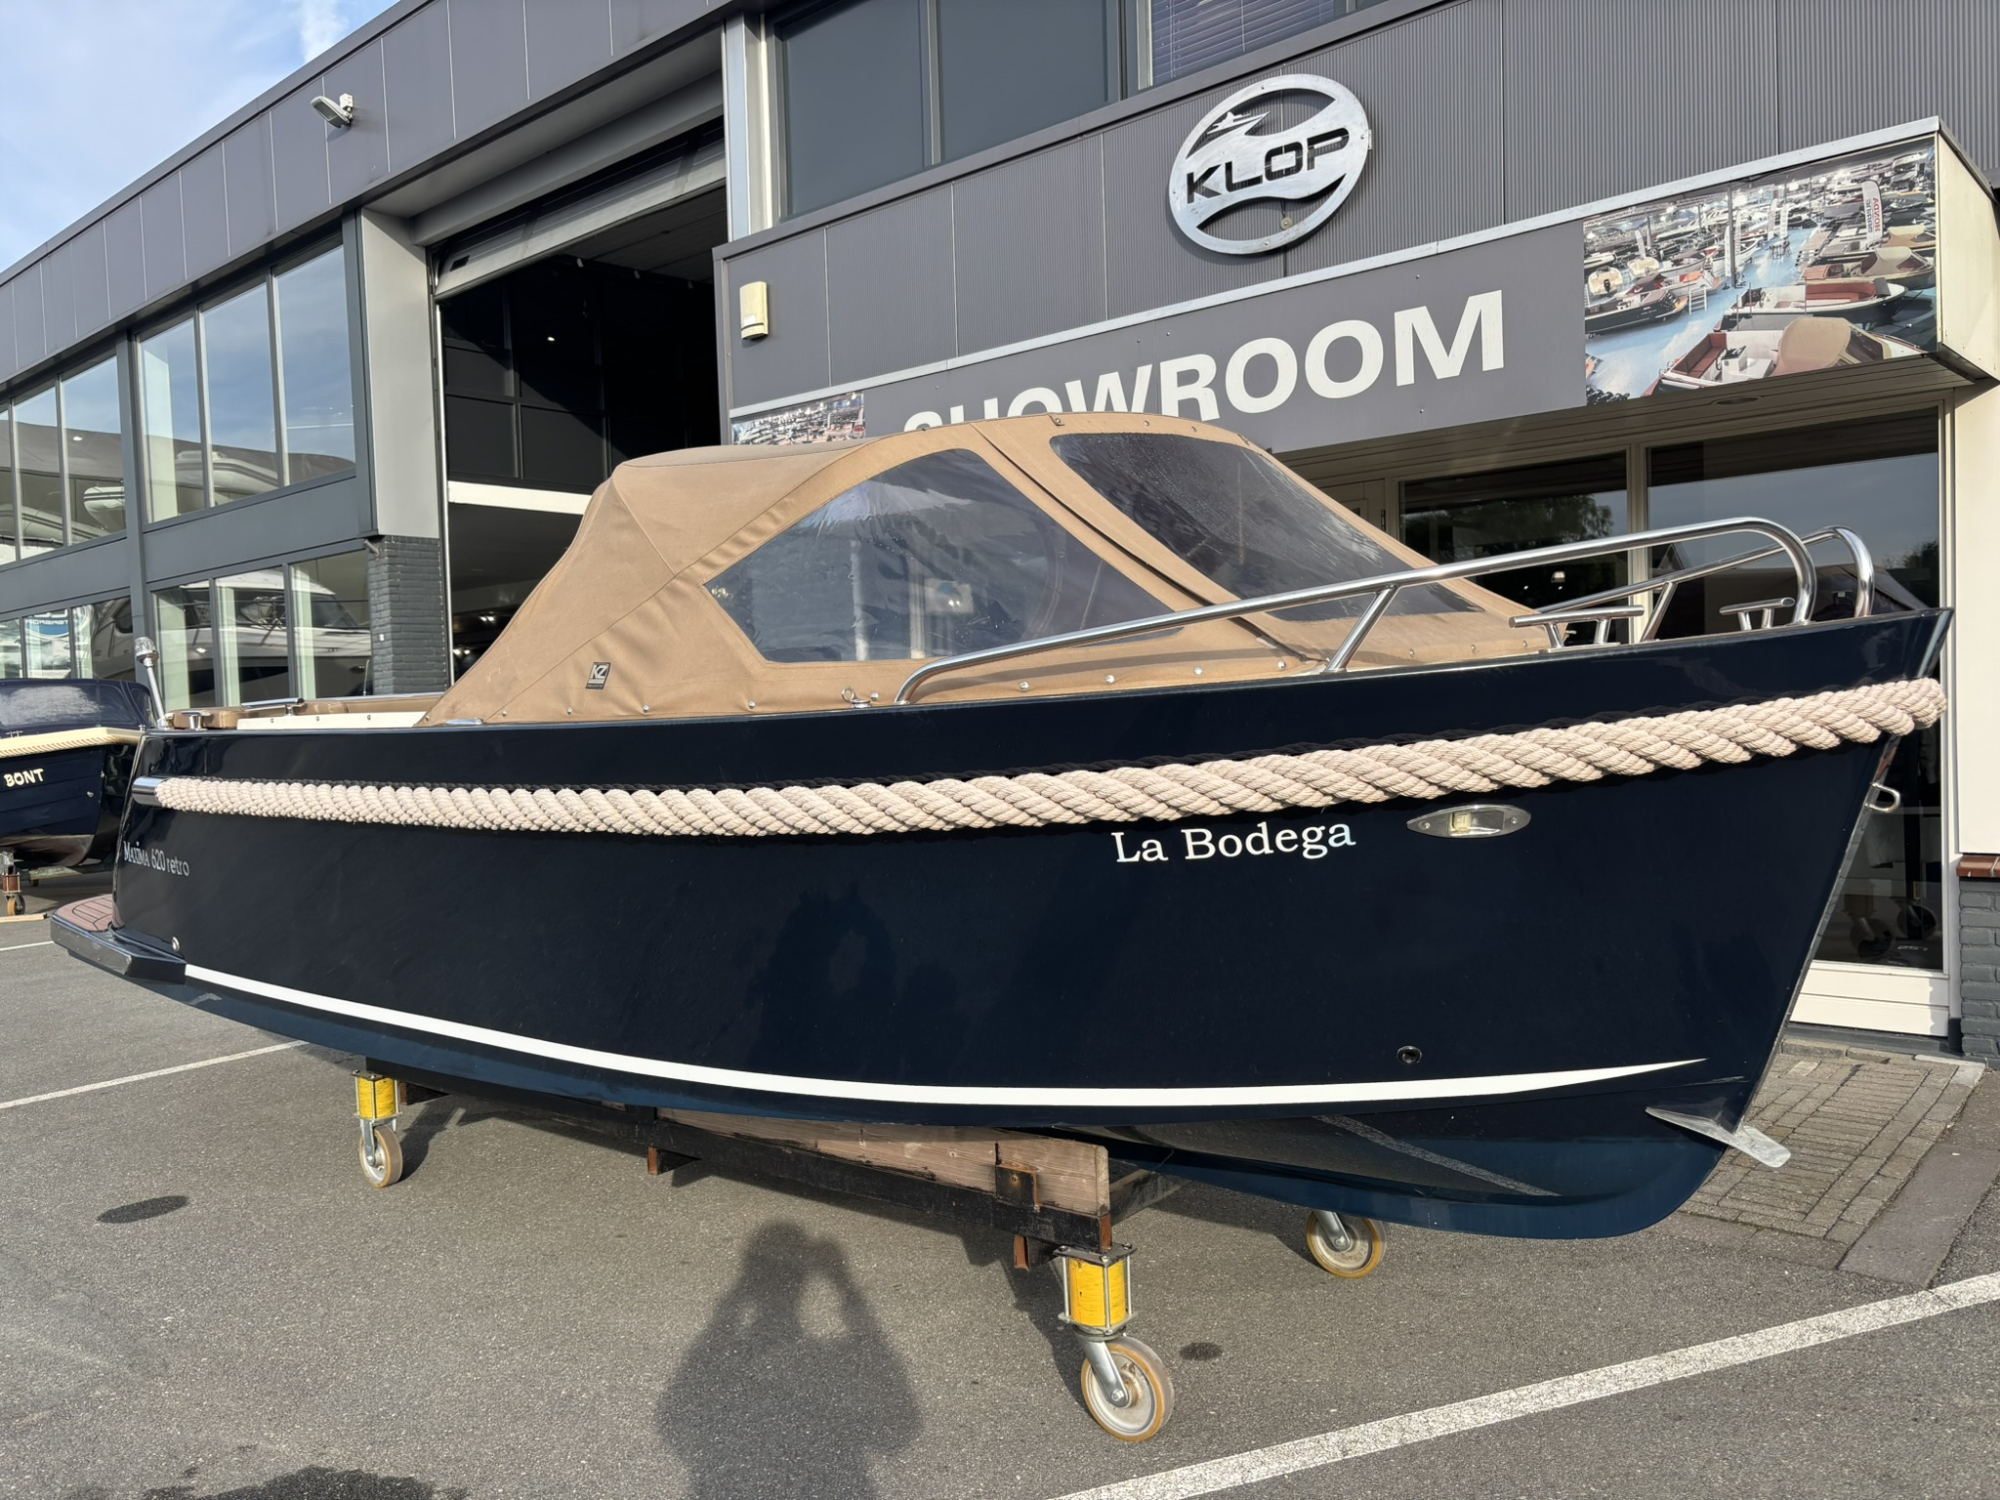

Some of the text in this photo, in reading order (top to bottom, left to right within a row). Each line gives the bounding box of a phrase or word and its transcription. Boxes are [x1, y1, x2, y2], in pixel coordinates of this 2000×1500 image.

[1186, 127, 1350, 205] KLOP
[3, 768, 44, 787] BONT
[1111, 822, 1357, 863] La Bodega
[151, 848, 166, 871] 620
[166, 856, 190, 876] retro
